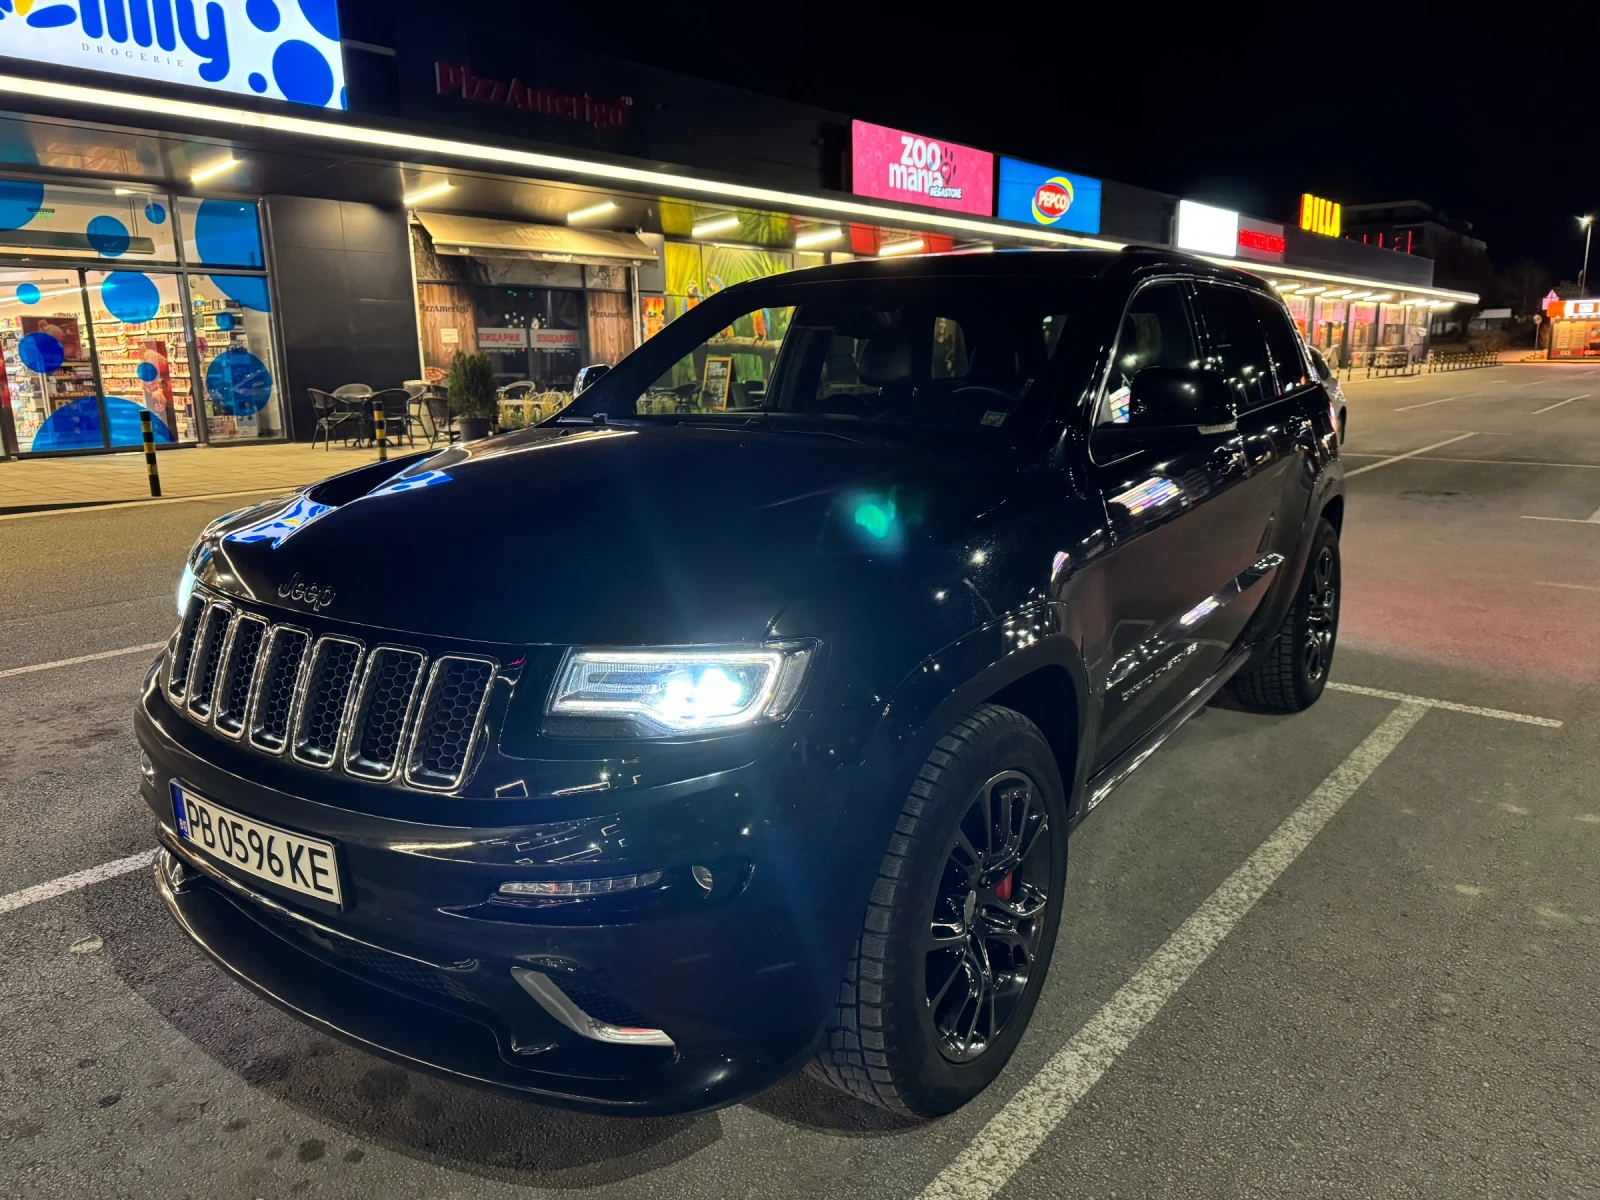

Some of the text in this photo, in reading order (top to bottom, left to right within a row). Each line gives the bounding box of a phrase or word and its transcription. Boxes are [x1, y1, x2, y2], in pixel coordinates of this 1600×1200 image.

[81, 42, 184, 68] DROGERIE
[900, 135, 941, 171] ZOO
[888, 162, 944, 194] mania
[1037, 189, 1068, 211] PEPCO
[1299, 193, 1340, 238] BILLA
[277, 572, 336, 612] Jeep
